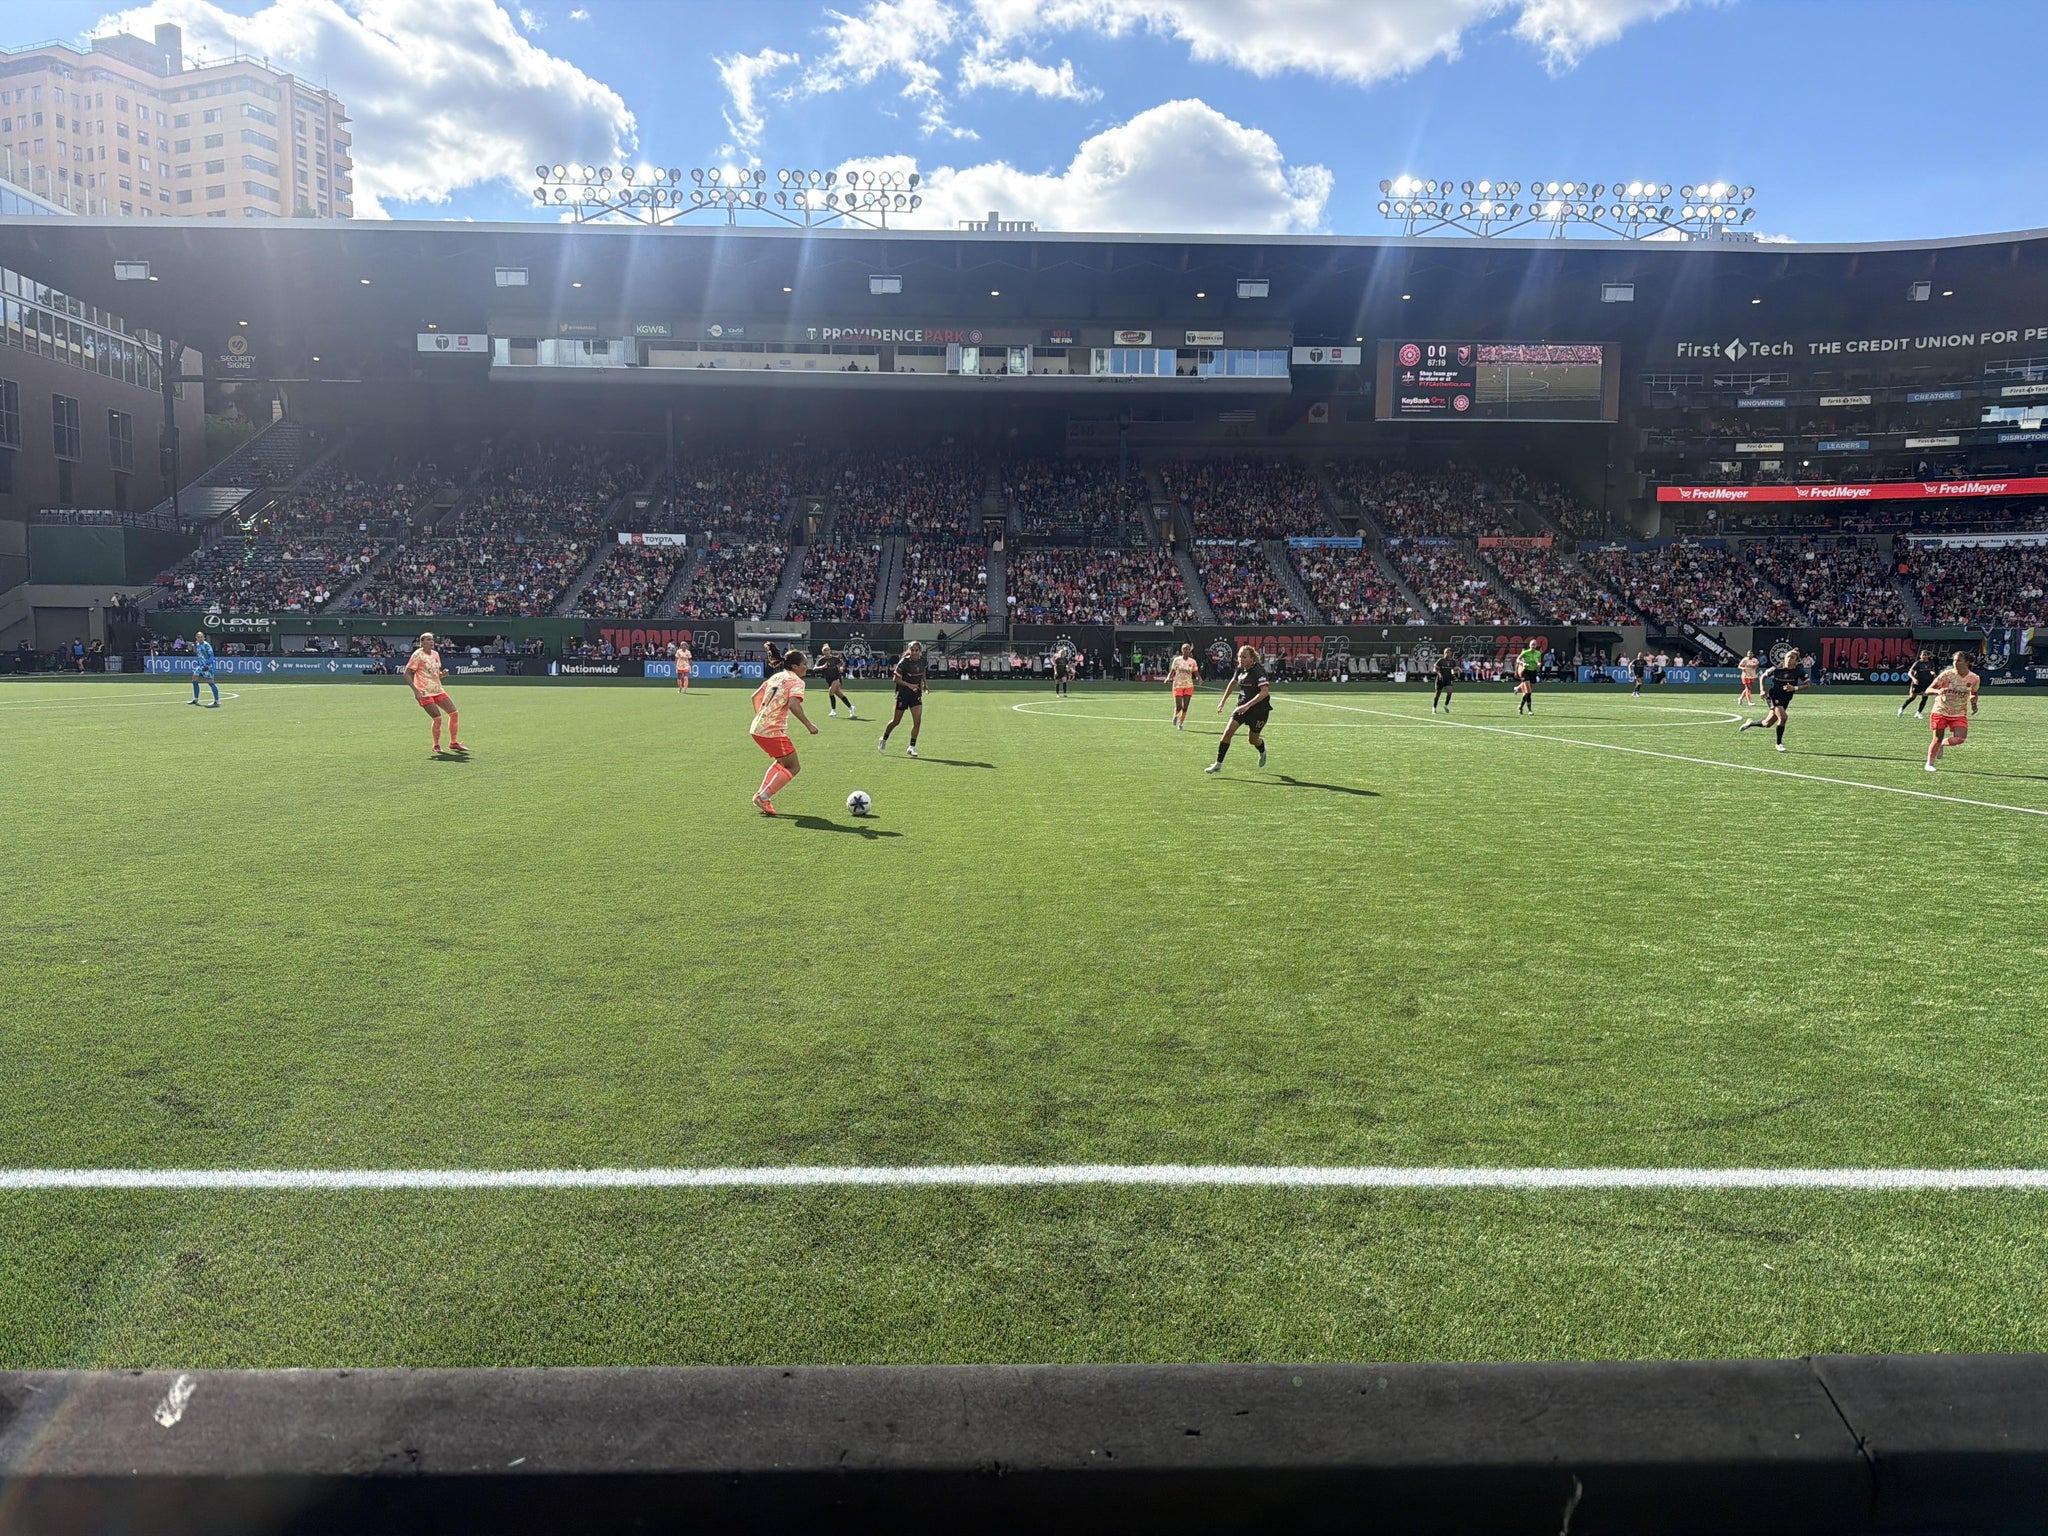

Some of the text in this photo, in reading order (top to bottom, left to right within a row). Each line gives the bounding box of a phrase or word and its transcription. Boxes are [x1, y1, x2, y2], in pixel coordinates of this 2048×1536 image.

[822, 327, 965, 342] PROVIDENCE PARK
[1808, 342, 1842, 355] THE
[1846, 338, 1910, 353] CREDIT
[1915, 334, 1975, 349] UNION
[1980, 330, 2019, 345] FOR
[1427, 345, 1435, 357] 0
[1438, 345, 1447, 357] 0
[1677, 340, 1794, 358] First Tech
[1427, 359, 1446, 367] 87:19
[1401, 397, 1430, 405] KeyBank
[1914, 392, 1955, 401] CREATORS
[1497, 538, 1533, 547] SETGEEK
[221, 618, 270, 626] LEXUS
[1820, 637, 1918, 669] THORNS
[146, 660, 171, 672] ring
[238, 660, 262, 673] ring
[455, 664, 496, 674] Tillamook
[561, 664, 619, 673] Nationwide
[647, 663, 671, 677] ring
[1667, 669, 1690, 682] ring
[1832, 672, 1865, 681] NWSL
[1989, 676, 2026, 686] Tillamook
